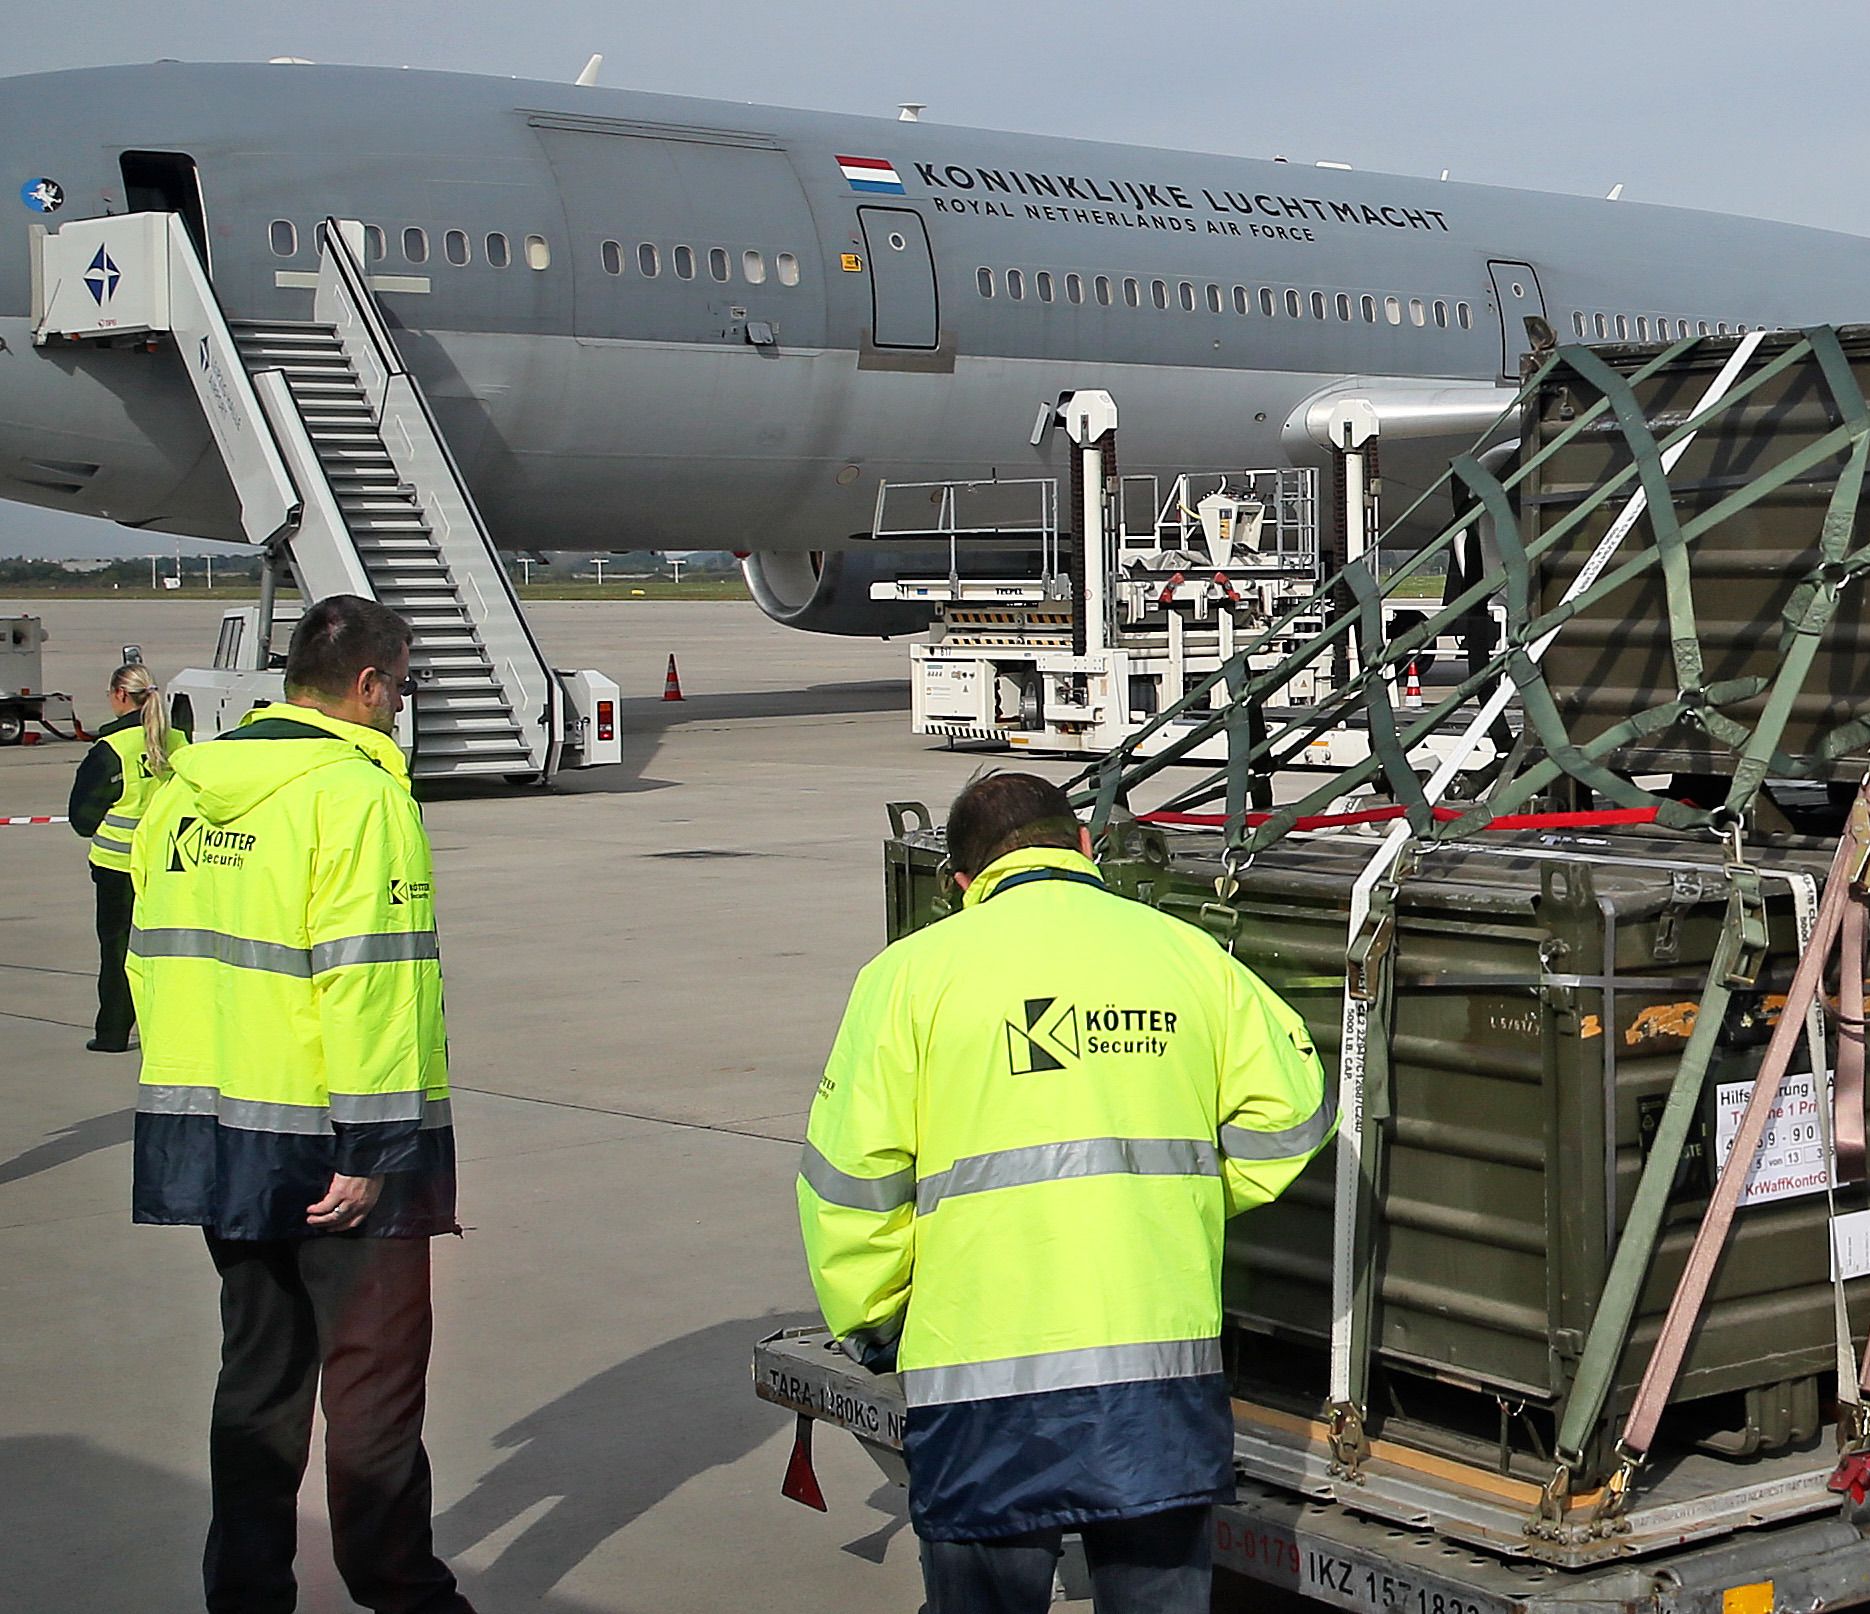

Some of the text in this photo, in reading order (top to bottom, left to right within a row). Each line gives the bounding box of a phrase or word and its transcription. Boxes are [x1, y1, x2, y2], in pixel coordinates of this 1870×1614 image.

[914, 161, 1194, 210] KONINKLIJKE
[1202, 188, 1449, 232] LUCHTMACHT
[934, 197, 1316, 242] ROYAL NETHERLANDS AIR FORCE
[1086, 1003, 1177, 1034] KÖTTER
[1346, 1009, 1355, 1034] 5000
[1087, 1036, 1168, 1057] Security
[1799, 1100, 1817, 1114] Pri
[1787, 1152, 1799, 1164] 13
[769, 1369, 814, 1406] TARA
[1217, 1519, 1300, 1574] D-0179
[1310, 1551, 1354, 1596] IKZ
